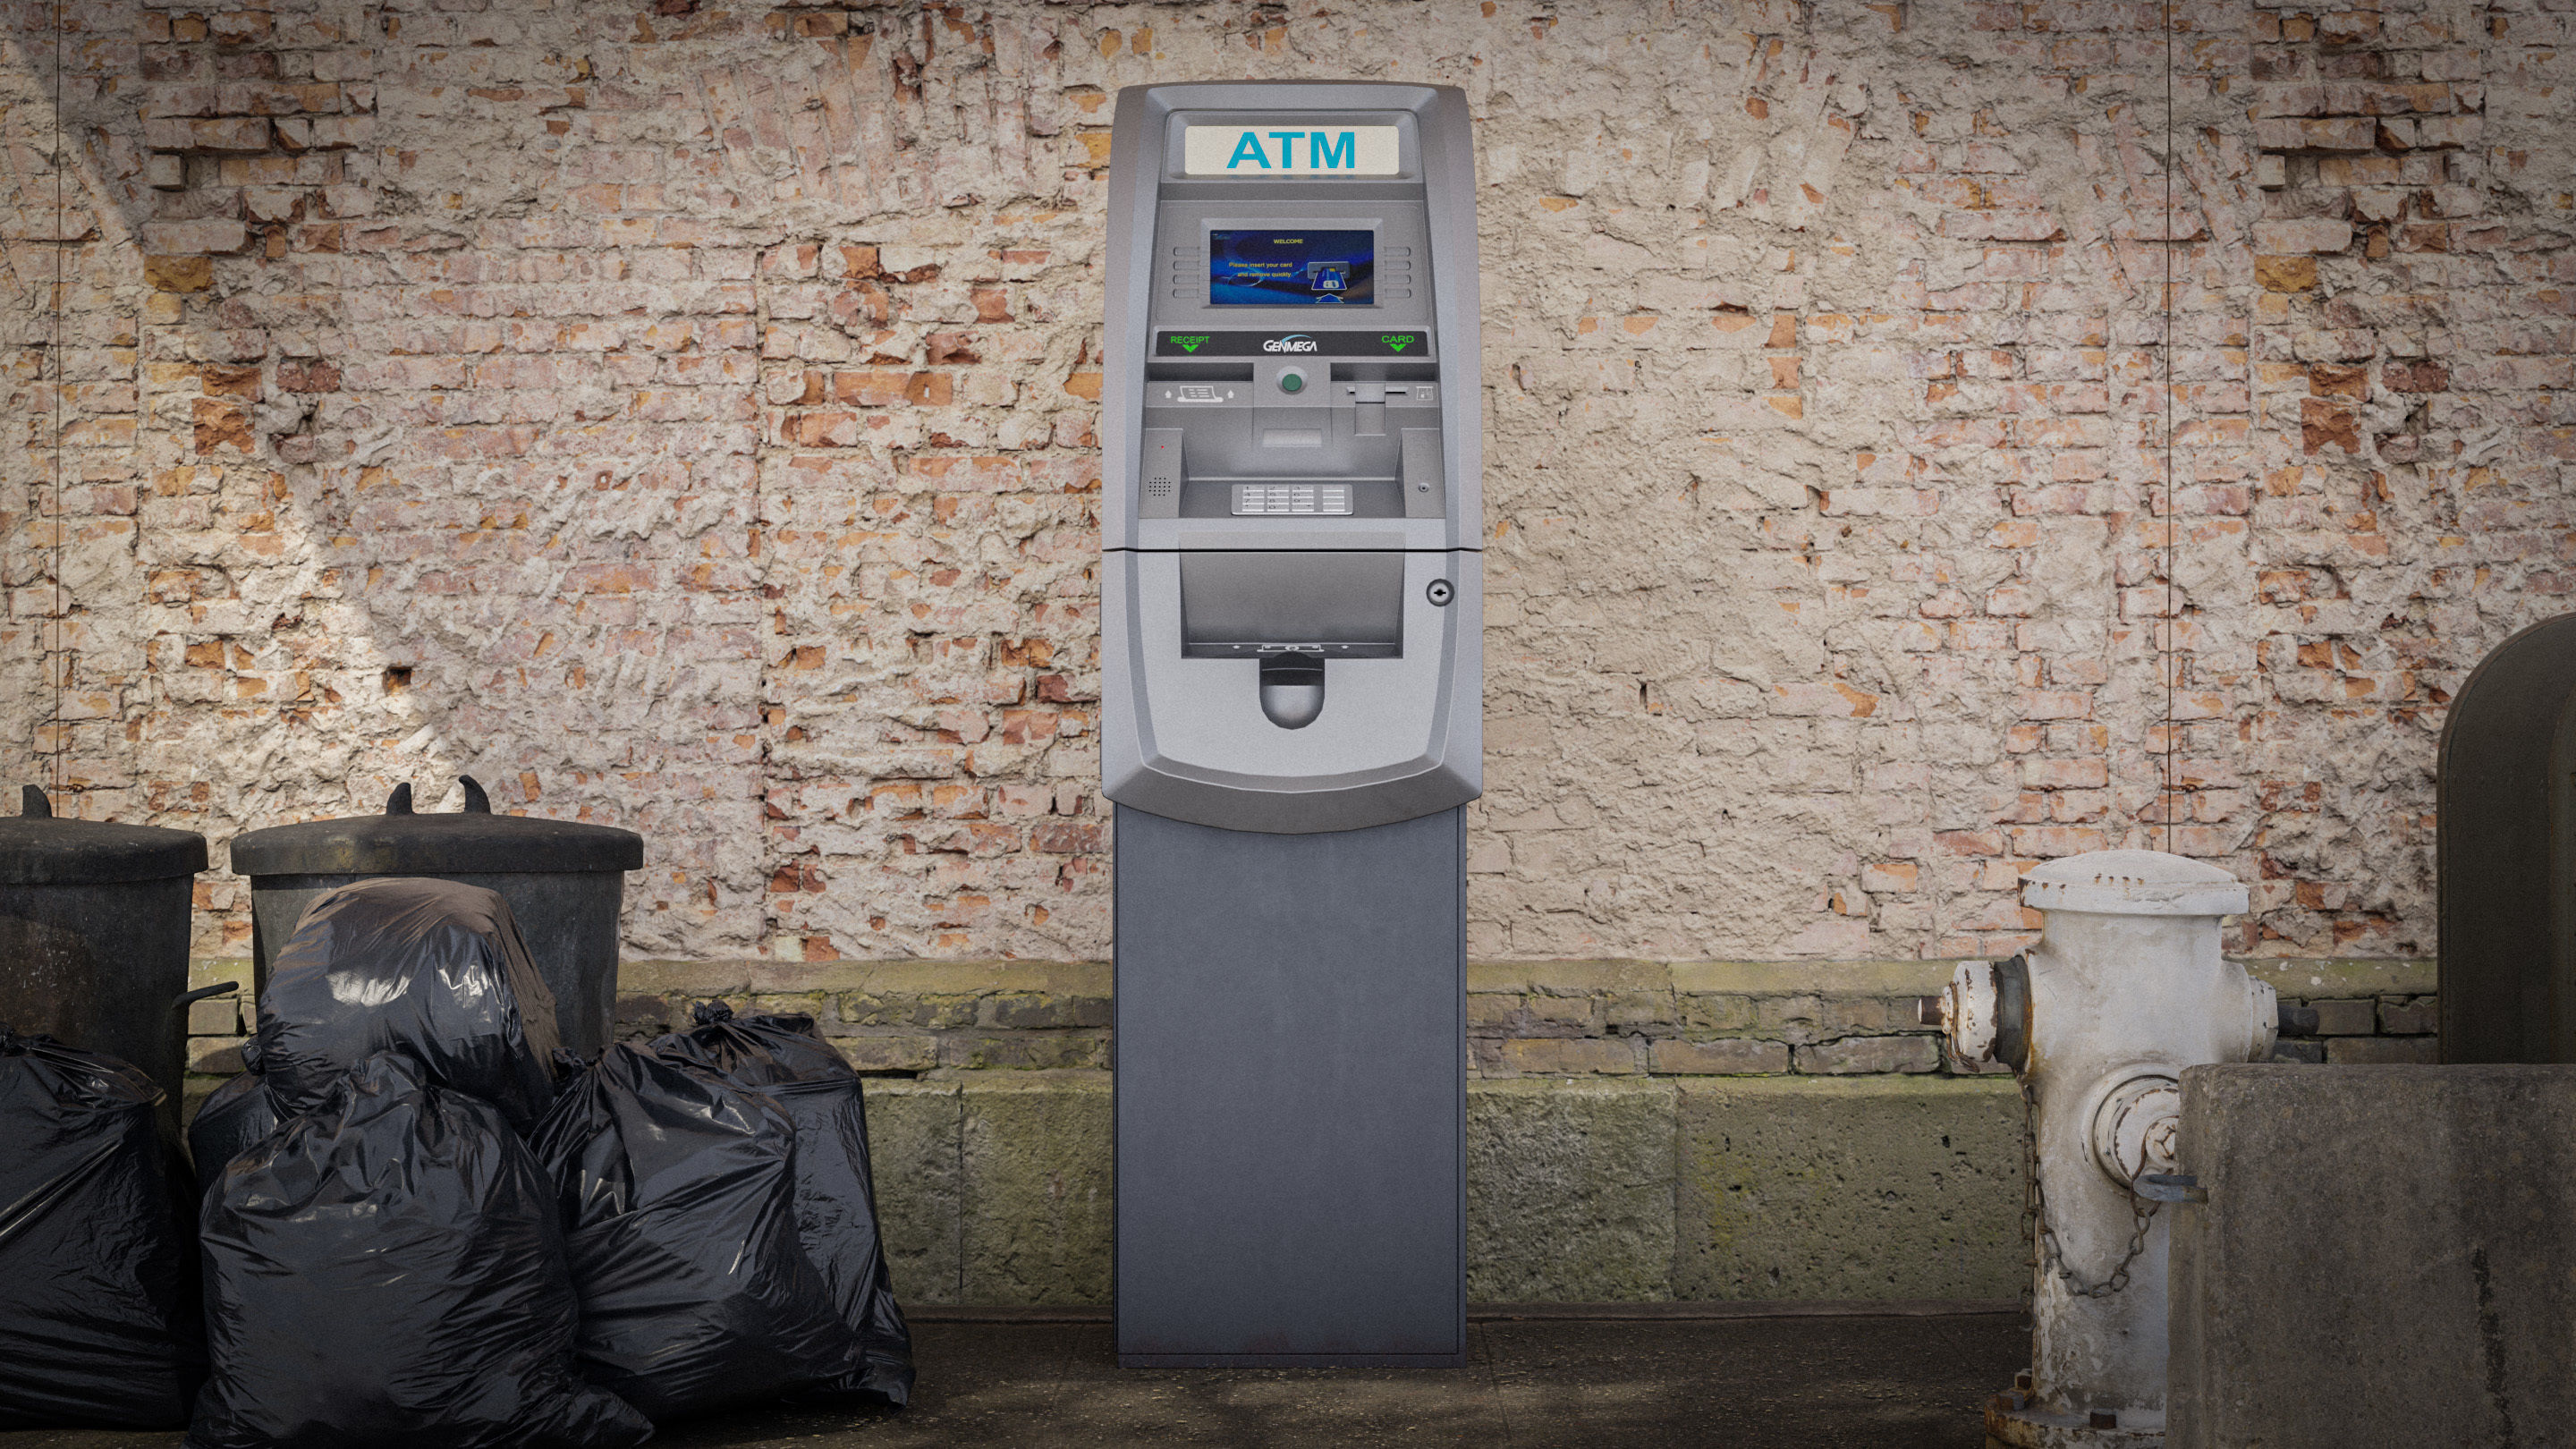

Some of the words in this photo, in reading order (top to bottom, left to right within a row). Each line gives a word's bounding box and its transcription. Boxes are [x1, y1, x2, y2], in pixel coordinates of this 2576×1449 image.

[1226, 131, 1355, 169] ATM
[1170, 335, 1210, 344] RECEIPT
[1381, 335, 1415, 343] CARD
[1263, 339, 1318, 353] GENMEGA
